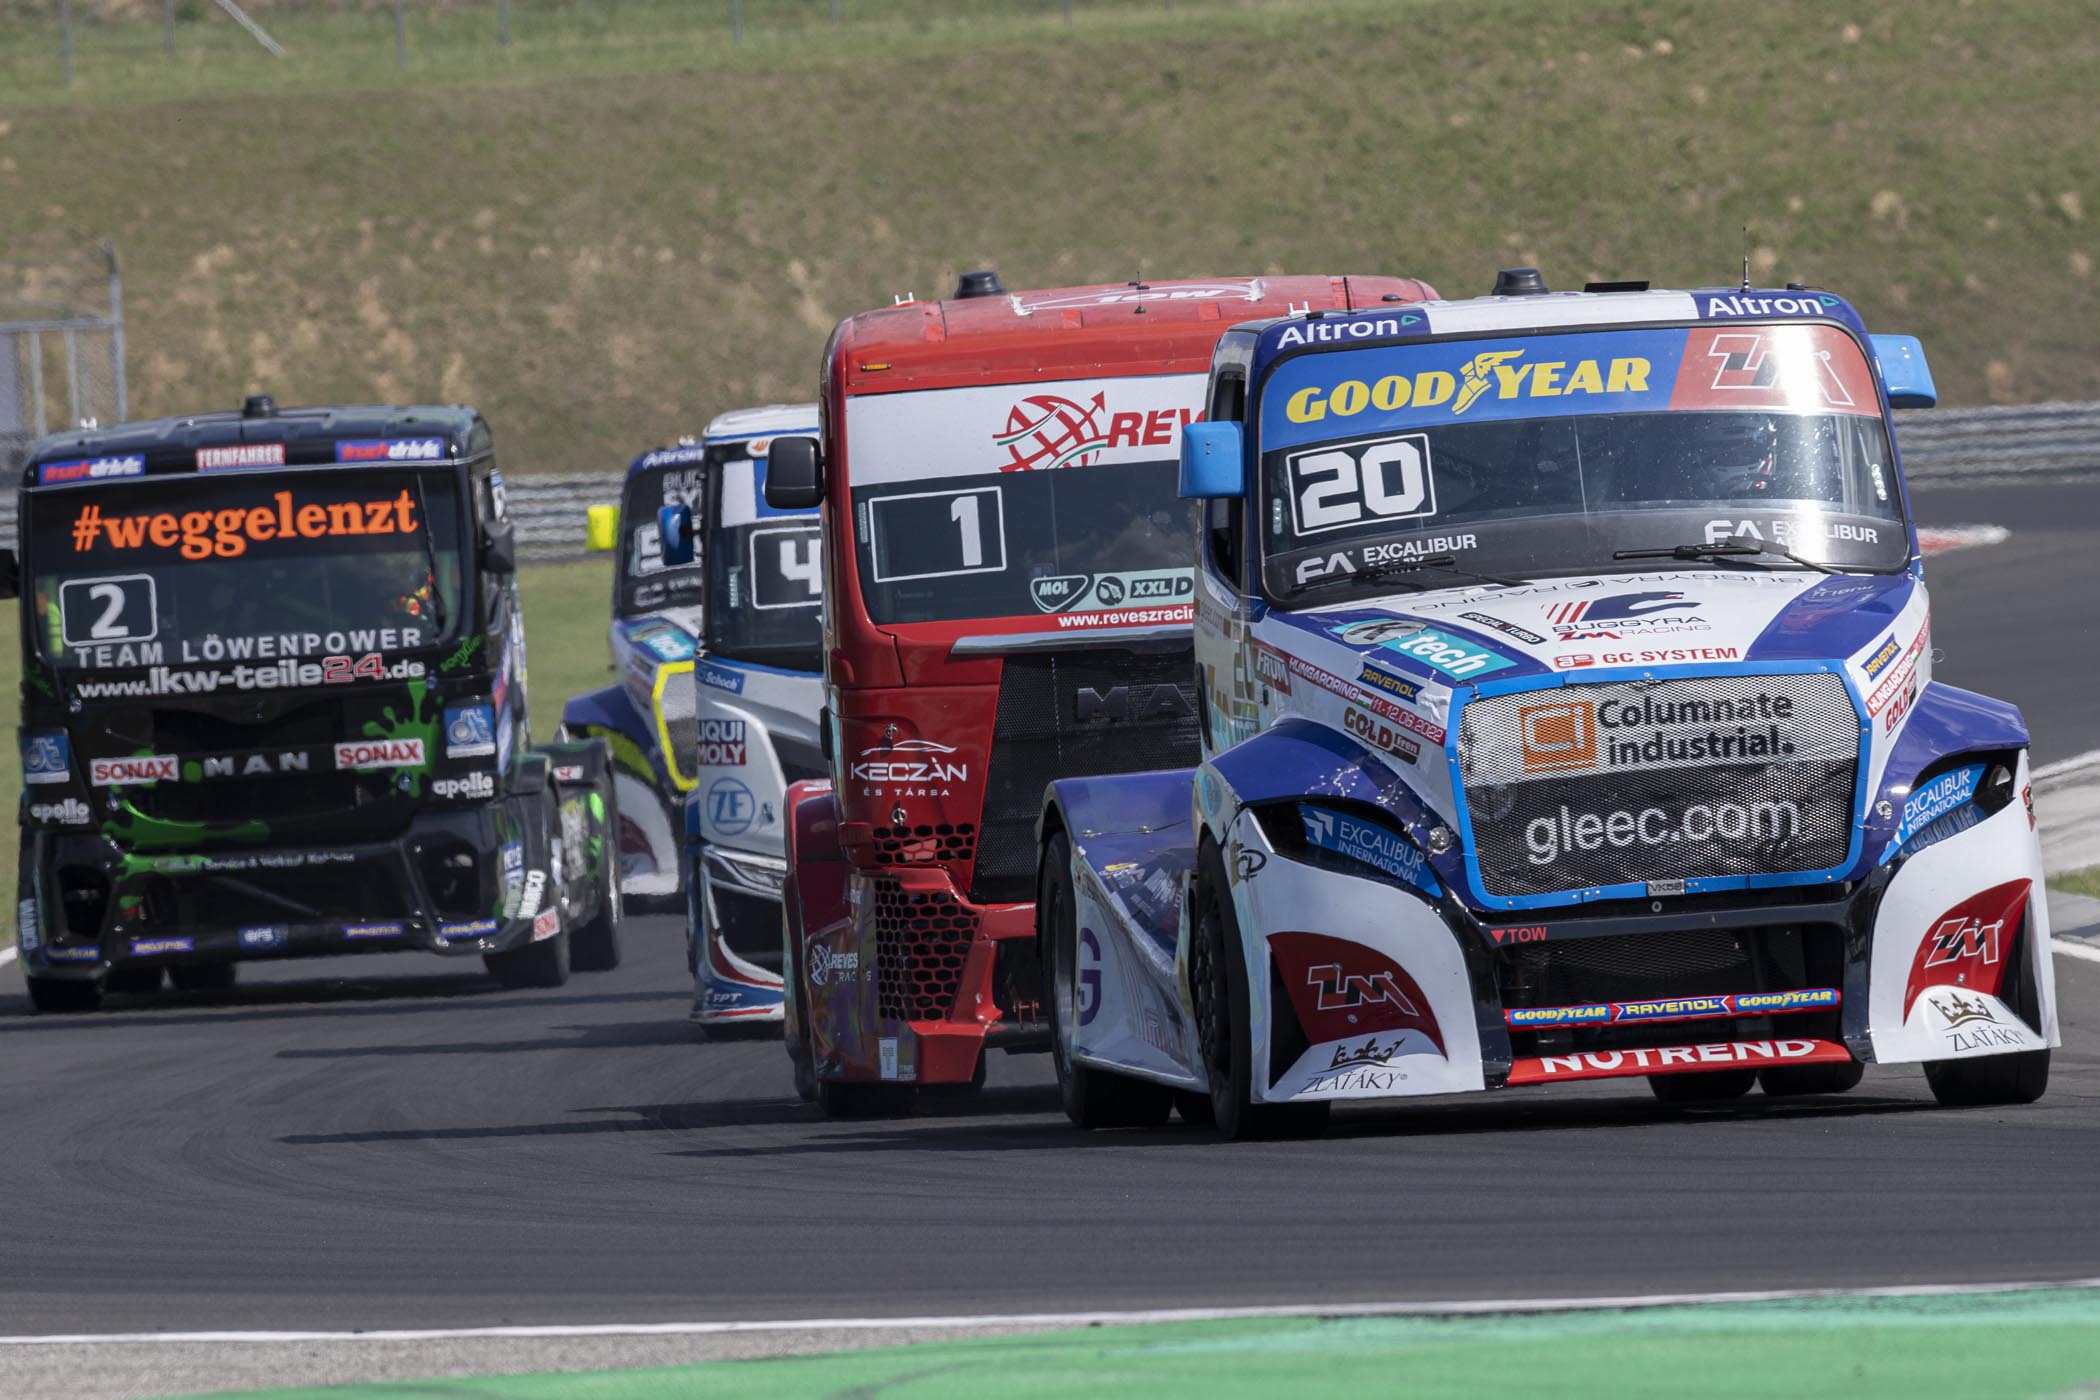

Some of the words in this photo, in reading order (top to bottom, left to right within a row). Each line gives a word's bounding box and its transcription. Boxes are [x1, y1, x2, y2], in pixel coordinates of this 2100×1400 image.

[1708, 295, 1824, 316] Altron
[1277, 318, 1398, 349] Altron
[198, 444, 284, 467] FERNFAHRER
[1298, 442, 1425, 528] 20
[72, 488, 418, 560] #weggelenzt
[951, 496, 982, 567] 1
[1772, 520, 1878, 543] EXLIBUR
[1363, 534, 1477, 562] EXCALIBUR
[780, 538, 822, 594] 4
[1039, 581, 1069, 596] MOL
[1133, 580, 1170, 596] XXL
[89, 583, 129, 638] 2
[1552, 616, 1708, 633] BUGGYRA
[1464, 612, 1504, 629] SPECIAL
[1506, 626, 1541, 643] TURBO
[1620, 624, 1712, 636] RACING
[75, 641, 164, 668] TEAM
[182, 628, 421, 662] LÖWENPOWER
[1400, 634, 1490, 675] tech
[1603, 653, 1633, 664] GC
[1640, 647, 1738, 662] SYSTEM
[1866, 640, 1898, 676] RAVENOL
[77, 652, 425, 698] www.lkw-teile24.de
[1256, 651, 1288, 686] FRUM
[1289, 657, 1360, 699] HUNGARORING
[1363, 668, 1417, 698] RAVENOL
[1867, 655, 1914, 713] HUNGARORING
[1598, 693, 1794, 728] Columnate
[1886, 688, 1909, 731] GOLD
[697, 720, 743, 742] IQUI
[1344, 706, 1394, 748] GOLD
[339, 741, 420, 765] SONAX
[1609, 724, 1796, 765] industrial.
[95, 760, 176, 782] SONAX
[204, 751, 308, 777] MAN
[432, 771, 493, 799] apollo
[895, 785, 950, 797] TÁRSA
[1904, 767, 1971, 822] EXCALIBUR
[30, 798, 90, 823] apollo
[1907, 786, 1972, 834] INTERNATIONAL
[1340, 821, 1424, 872] EXCALIBUR
[1525, 800, 1800, 865] gleec.com
[1338, 841, 1418, 885] INTERNATIONAL
[1507, 927, 1548, 943] TOW
[830, 953, 858, 969] REVES
[1514, 1006, 1606, 1021] GOODYEAR
[1625, 999, 1720, 1015] RAVENOL
[1738, 991, 1833, 1007] GOODYEAR
[1541, 1040, 1818, 1073] NUTREND
